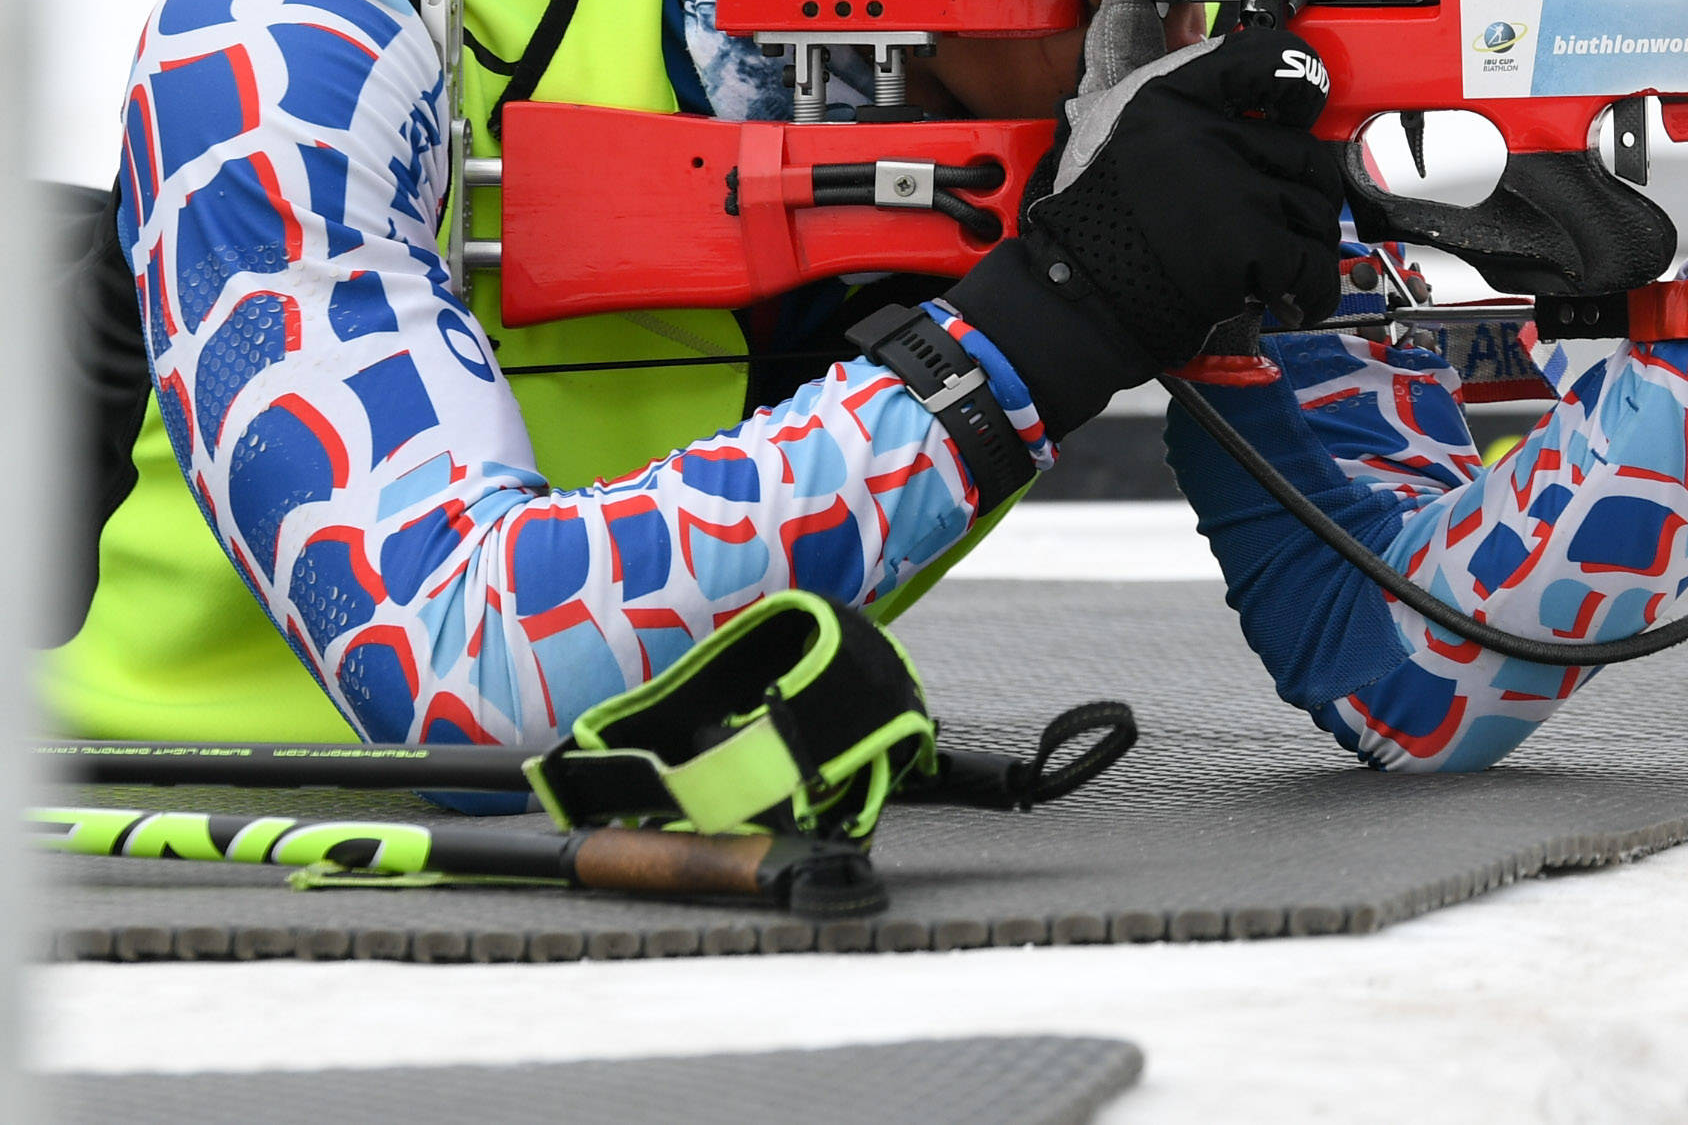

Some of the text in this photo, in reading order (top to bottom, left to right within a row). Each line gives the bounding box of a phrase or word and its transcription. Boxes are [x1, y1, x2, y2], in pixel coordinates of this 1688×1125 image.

[1483, 64, 1518, 72] BIATHLON
[81, 747, 151, 755] DIAMOND
[152, 747, 199, 756] LIGHT
[199, 748, 253, 756] SUPER
[272, 749, 430, 758] ONEWAYSPORT.COM
